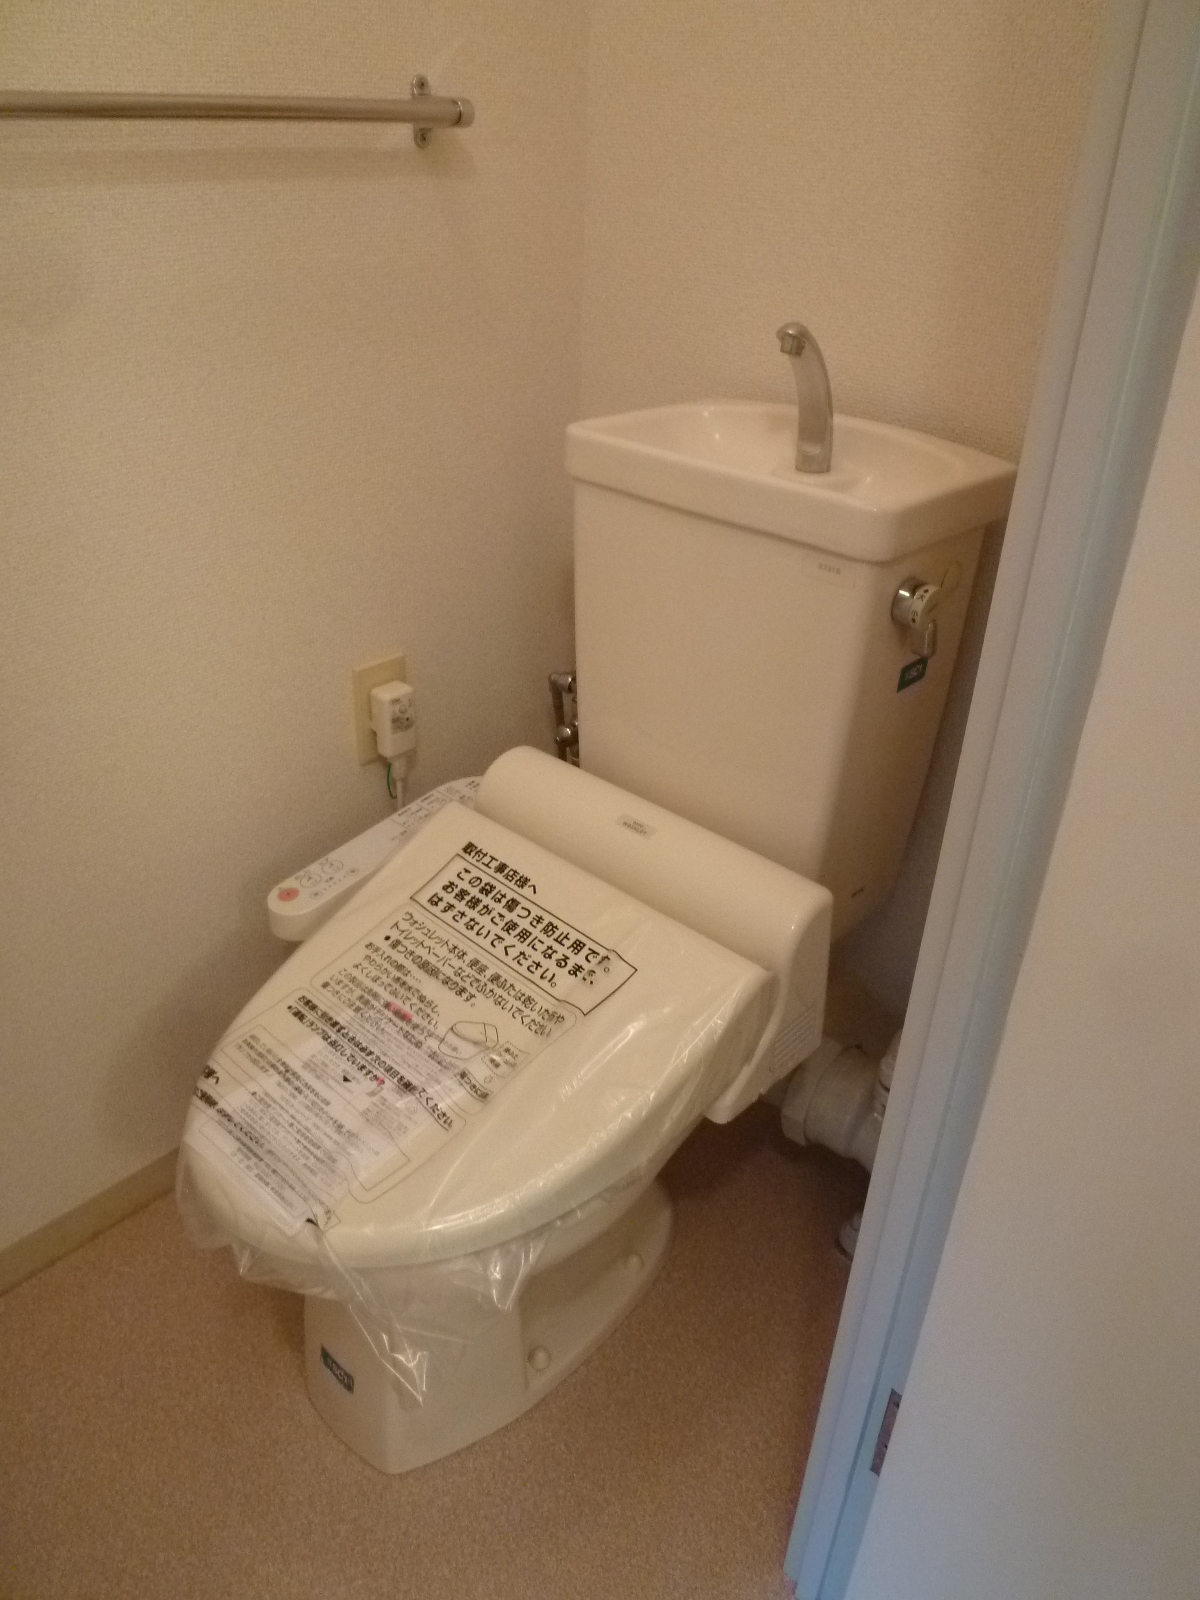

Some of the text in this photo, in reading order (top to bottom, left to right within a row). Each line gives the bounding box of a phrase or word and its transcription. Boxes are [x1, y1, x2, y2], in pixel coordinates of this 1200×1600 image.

[461, 841, 537, 894] 取付工事店様へ
